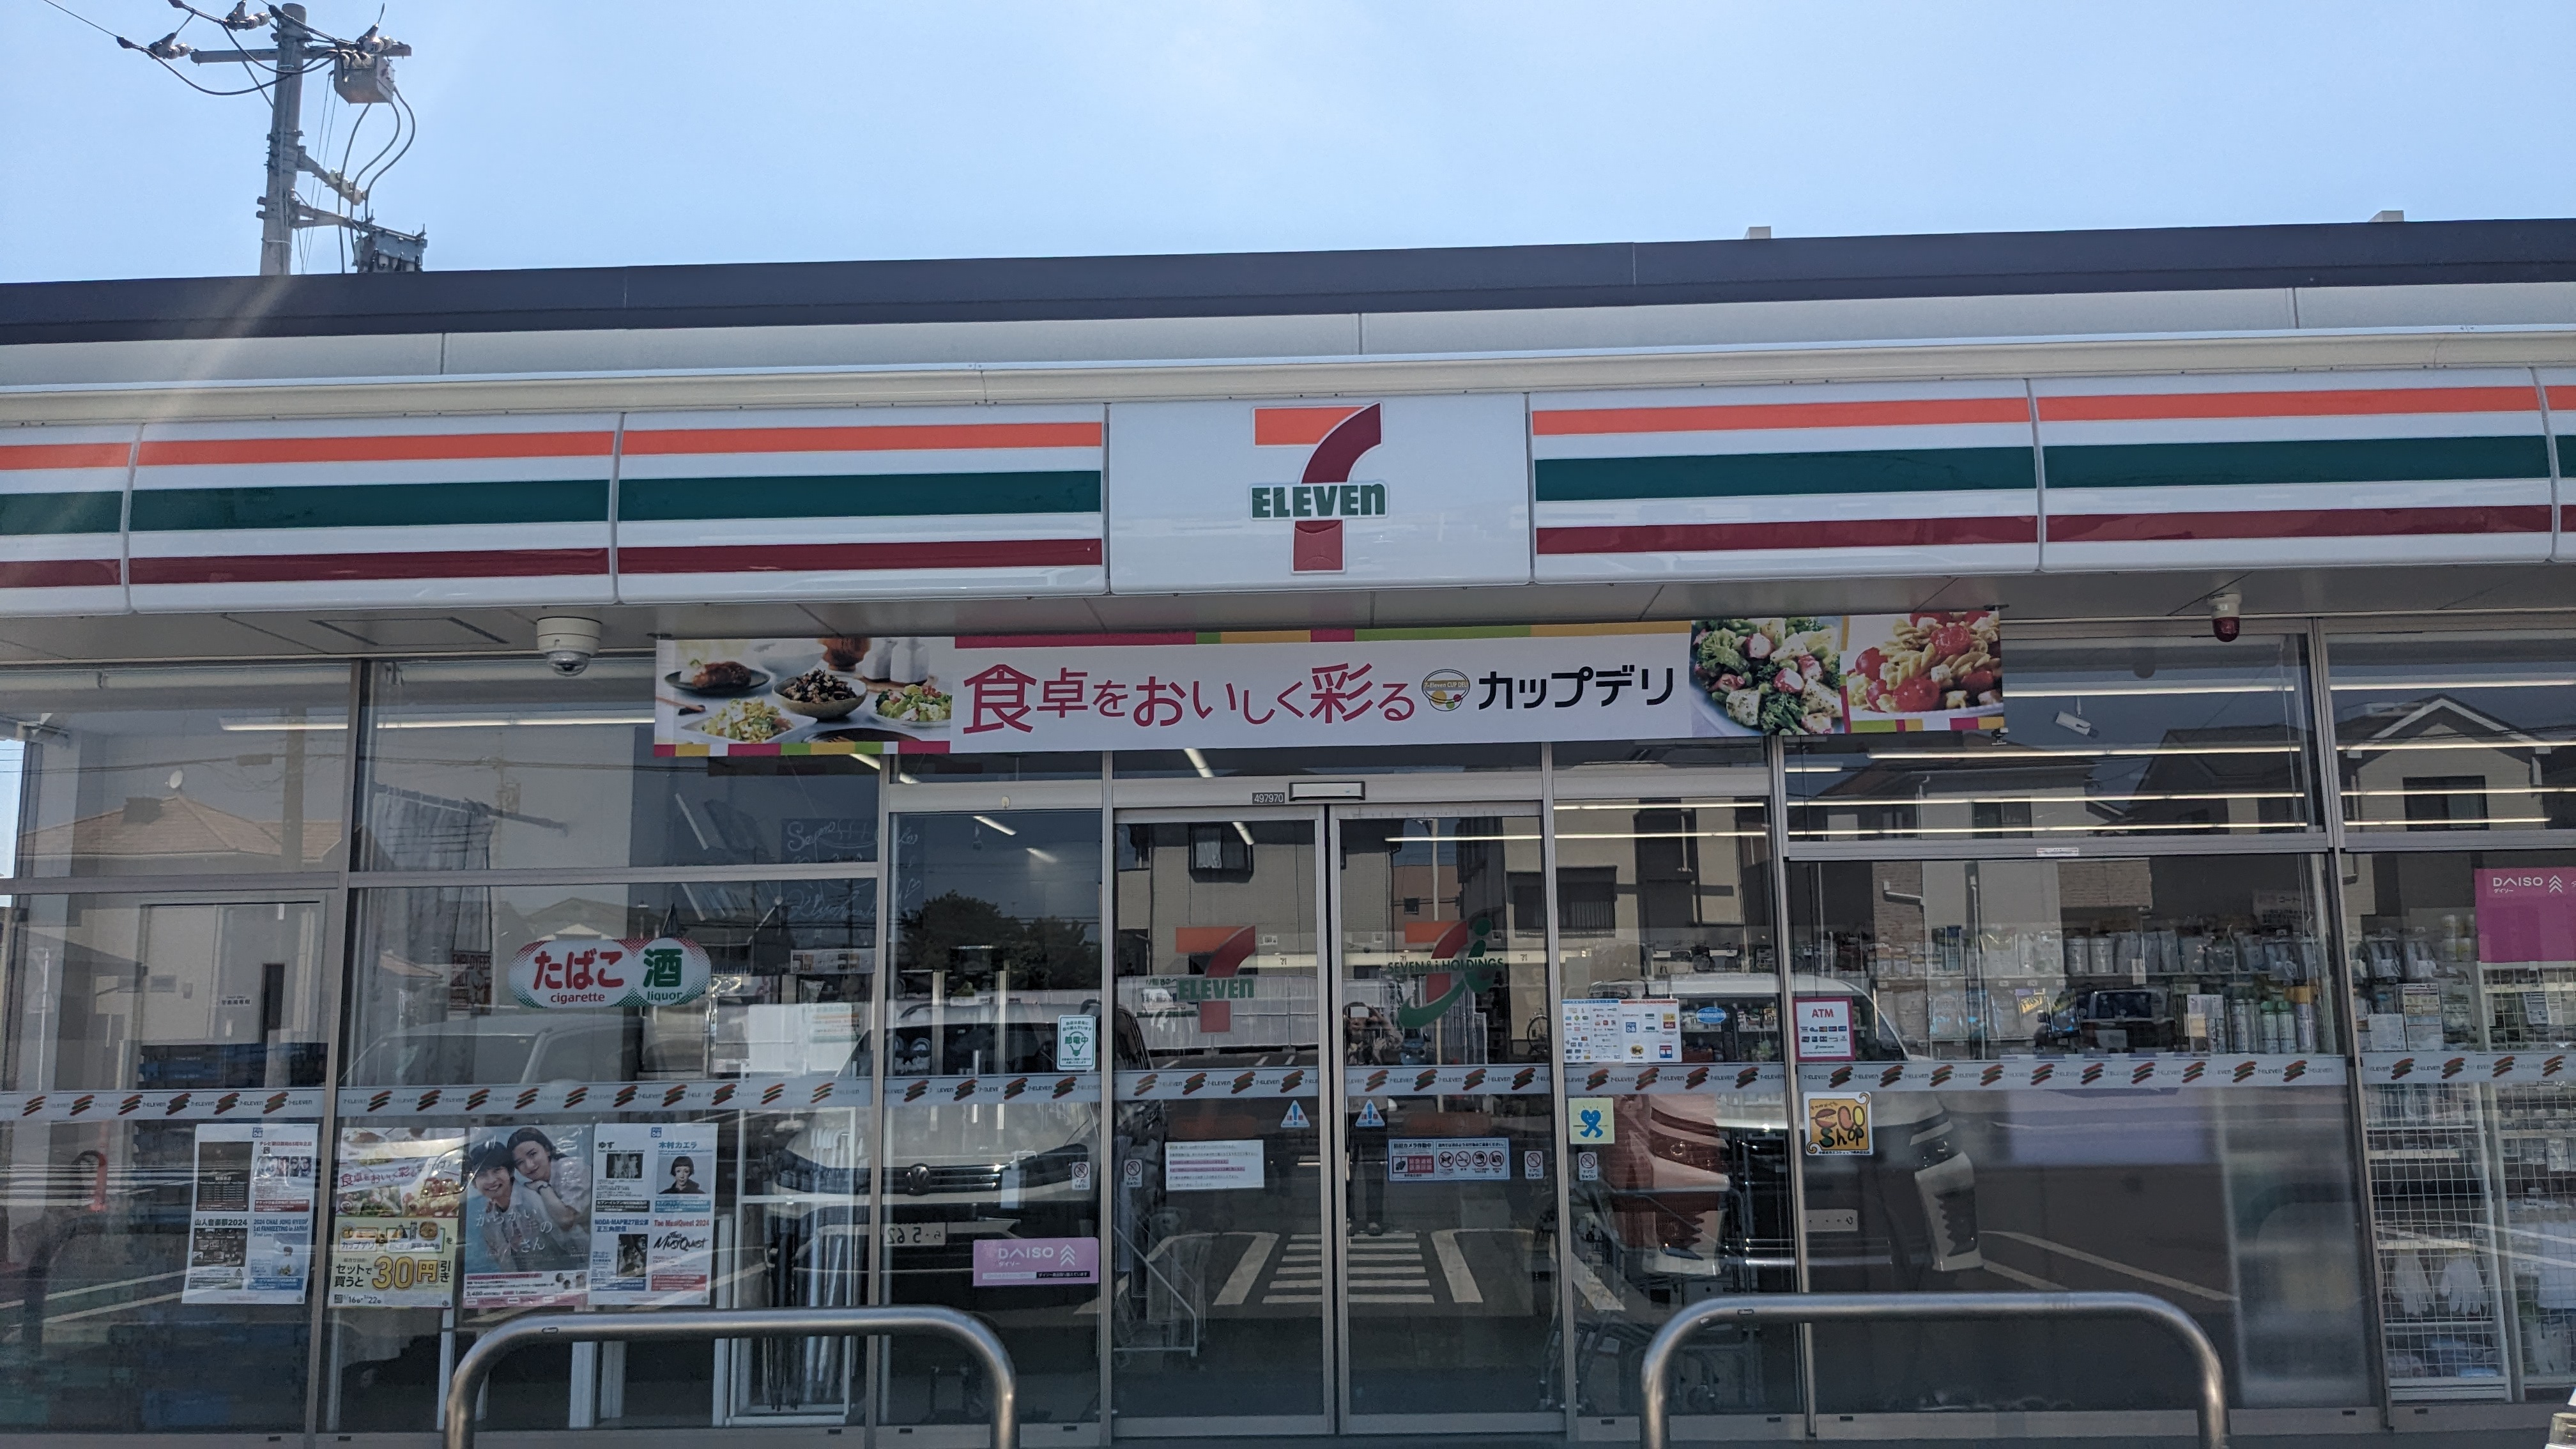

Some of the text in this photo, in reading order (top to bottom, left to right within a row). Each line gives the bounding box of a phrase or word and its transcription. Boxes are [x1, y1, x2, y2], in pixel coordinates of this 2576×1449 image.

[1479, 664, 1673, 710] カップデリ
[963, 663, 1414, 735] 食卓をおいしく彩る
[1254, 793, 1284, 803] 497970
[533, 947, 624, 990] たばこ
[643, 948, 684, 988] 酒
[1441, 958, 1504, 972] HOLDINGS
[551, 992, 606, 1004] cigarette
[647, 990, 683, 1002] liquor
[1811, 1009, 1834, 1018] ATM
[336, 1263, 372, 1275] セットで
[334, 1276, 364, 1287] 買うと
